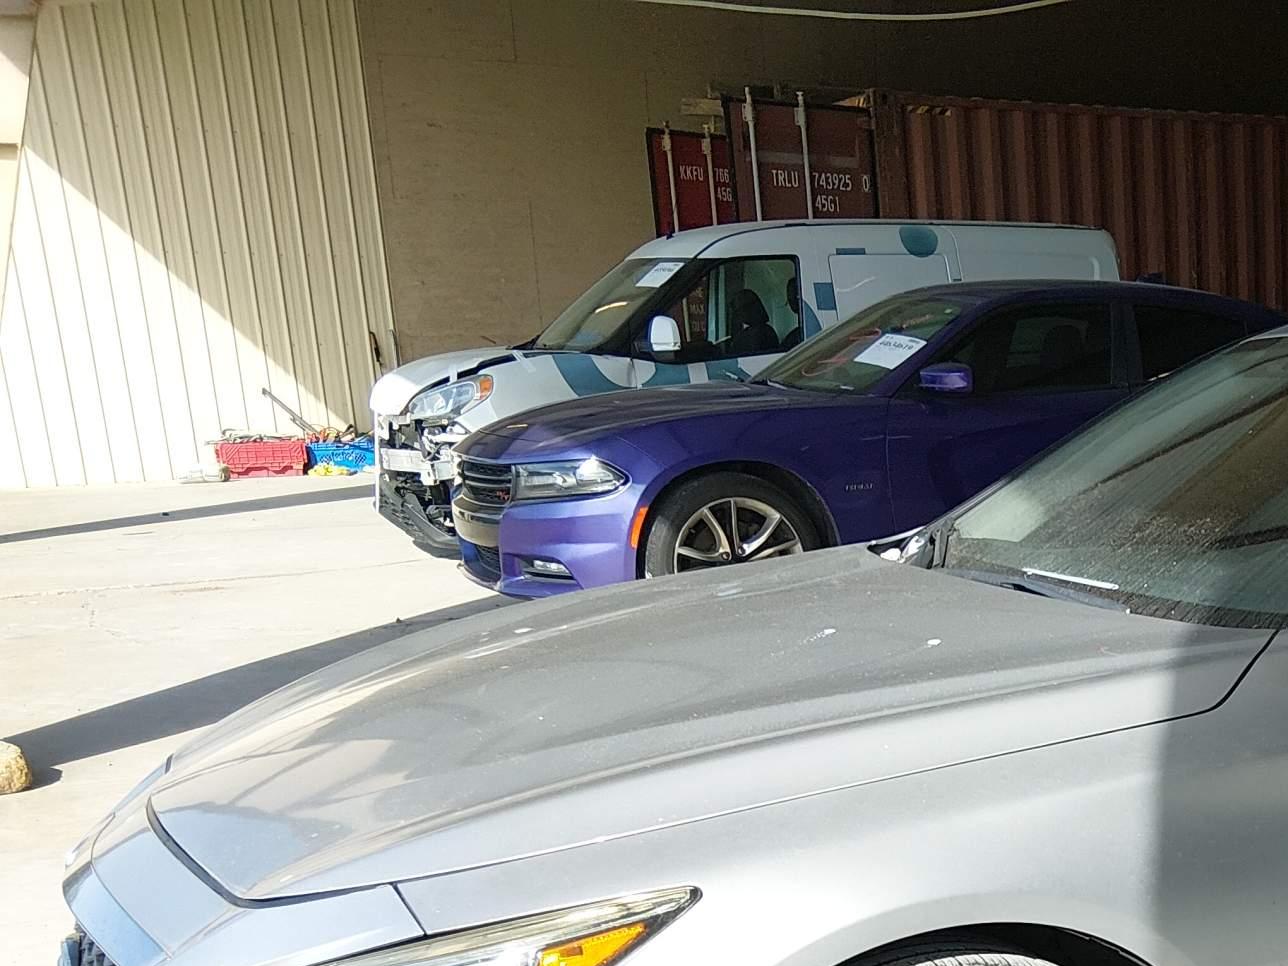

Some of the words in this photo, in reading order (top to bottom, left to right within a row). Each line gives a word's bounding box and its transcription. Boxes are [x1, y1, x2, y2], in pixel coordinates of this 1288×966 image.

[679, 165, 704, 181] KKFU
[771, 169, 800, 188] TRLU
[812, 172, 853, 191] 743925
[815, 195, 840, 213] 45G1
